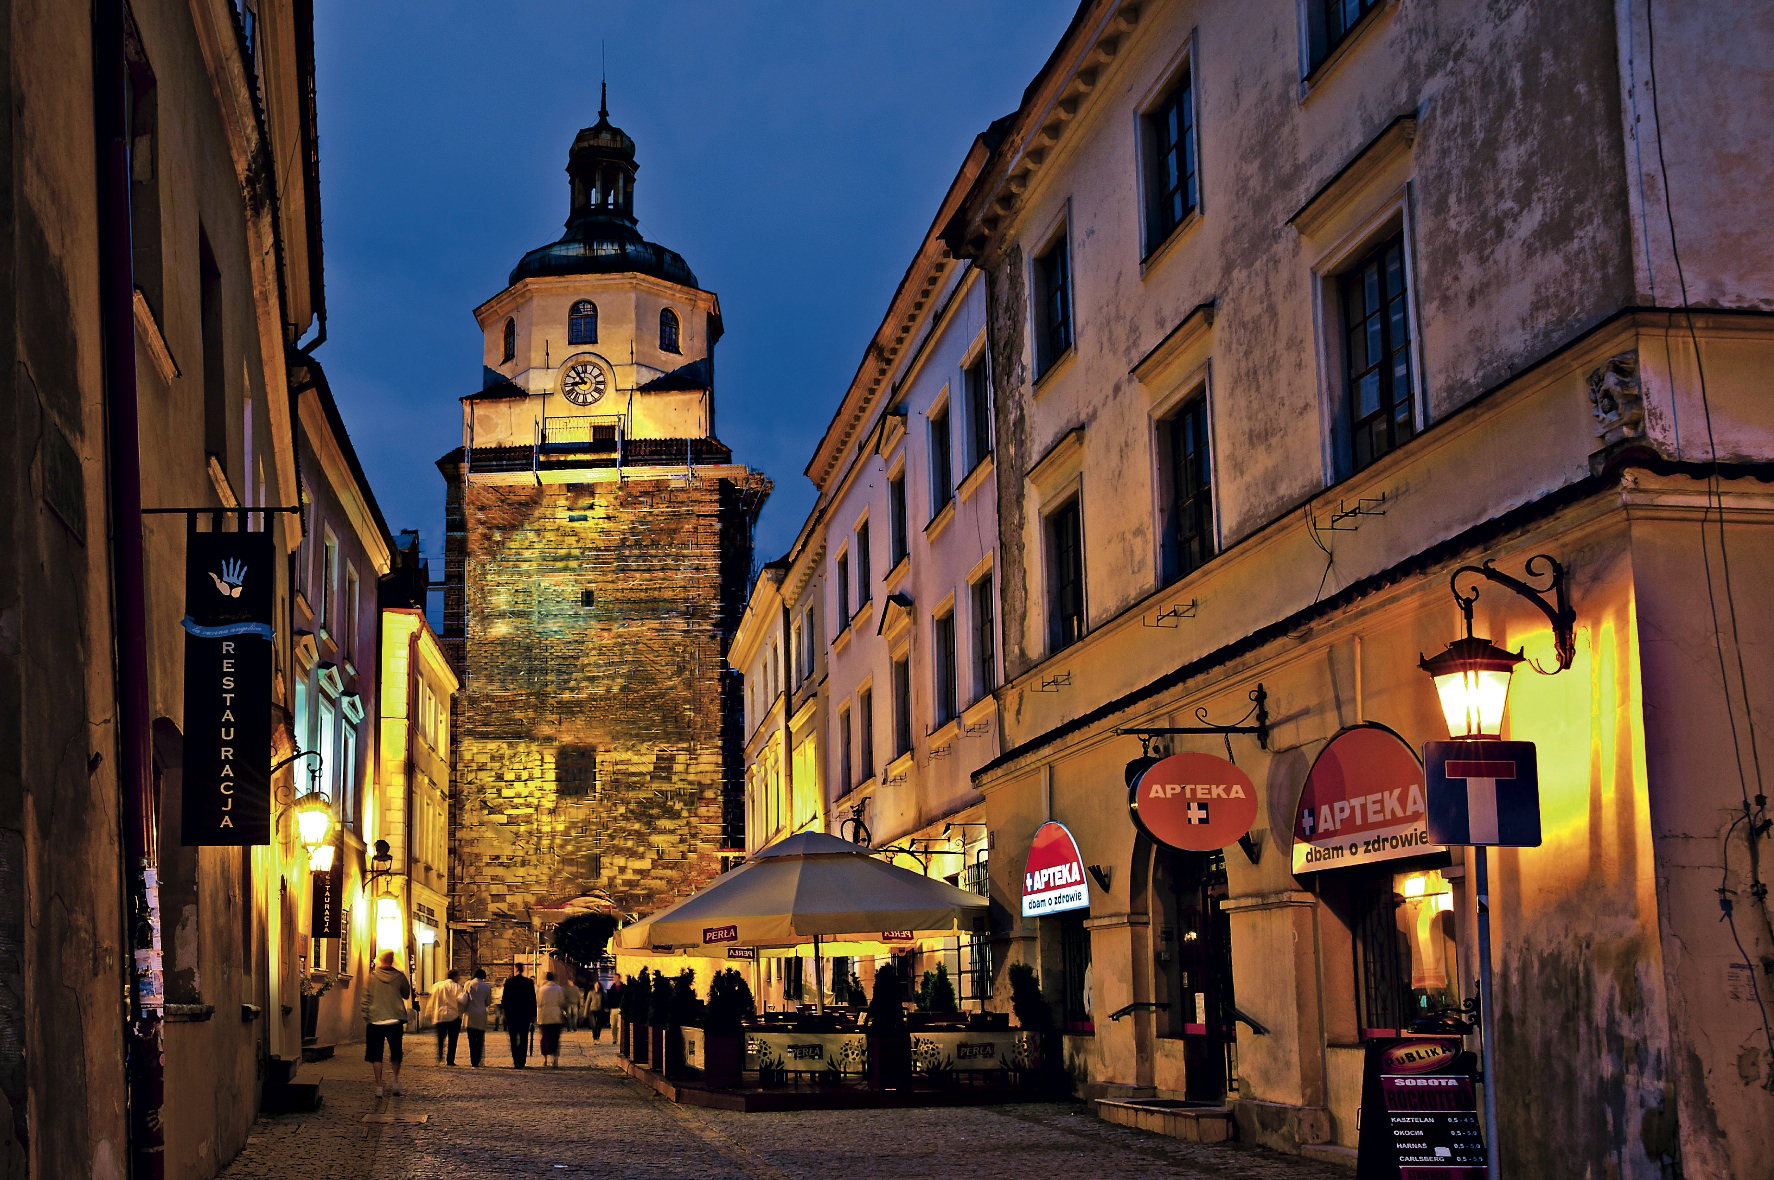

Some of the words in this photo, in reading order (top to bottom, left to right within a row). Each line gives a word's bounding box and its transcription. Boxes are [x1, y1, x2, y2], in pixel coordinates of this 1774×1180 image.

[220, 641, 235, 828] RESTAURACJA
[1148, 783, 1247, 799] APTEKA
[1318, 784, 1426, 833] APTEKA
[1305, 844, 1345, 863] dbam
[1349, 842, 1359, 856] o
[1363, 828, 1429, 854] zdrowie
[1033, 861, 1081, 891] APTEKA
[323, 873, 331, 933] ESTAURACJA
[1028, 898, 1047, 910] dbam
[1047, 897, 1053, 906] o
[1054, 890, 1082, 906] zdrowie
[1387, 1044, 1453, 1067] PUBLIKA
